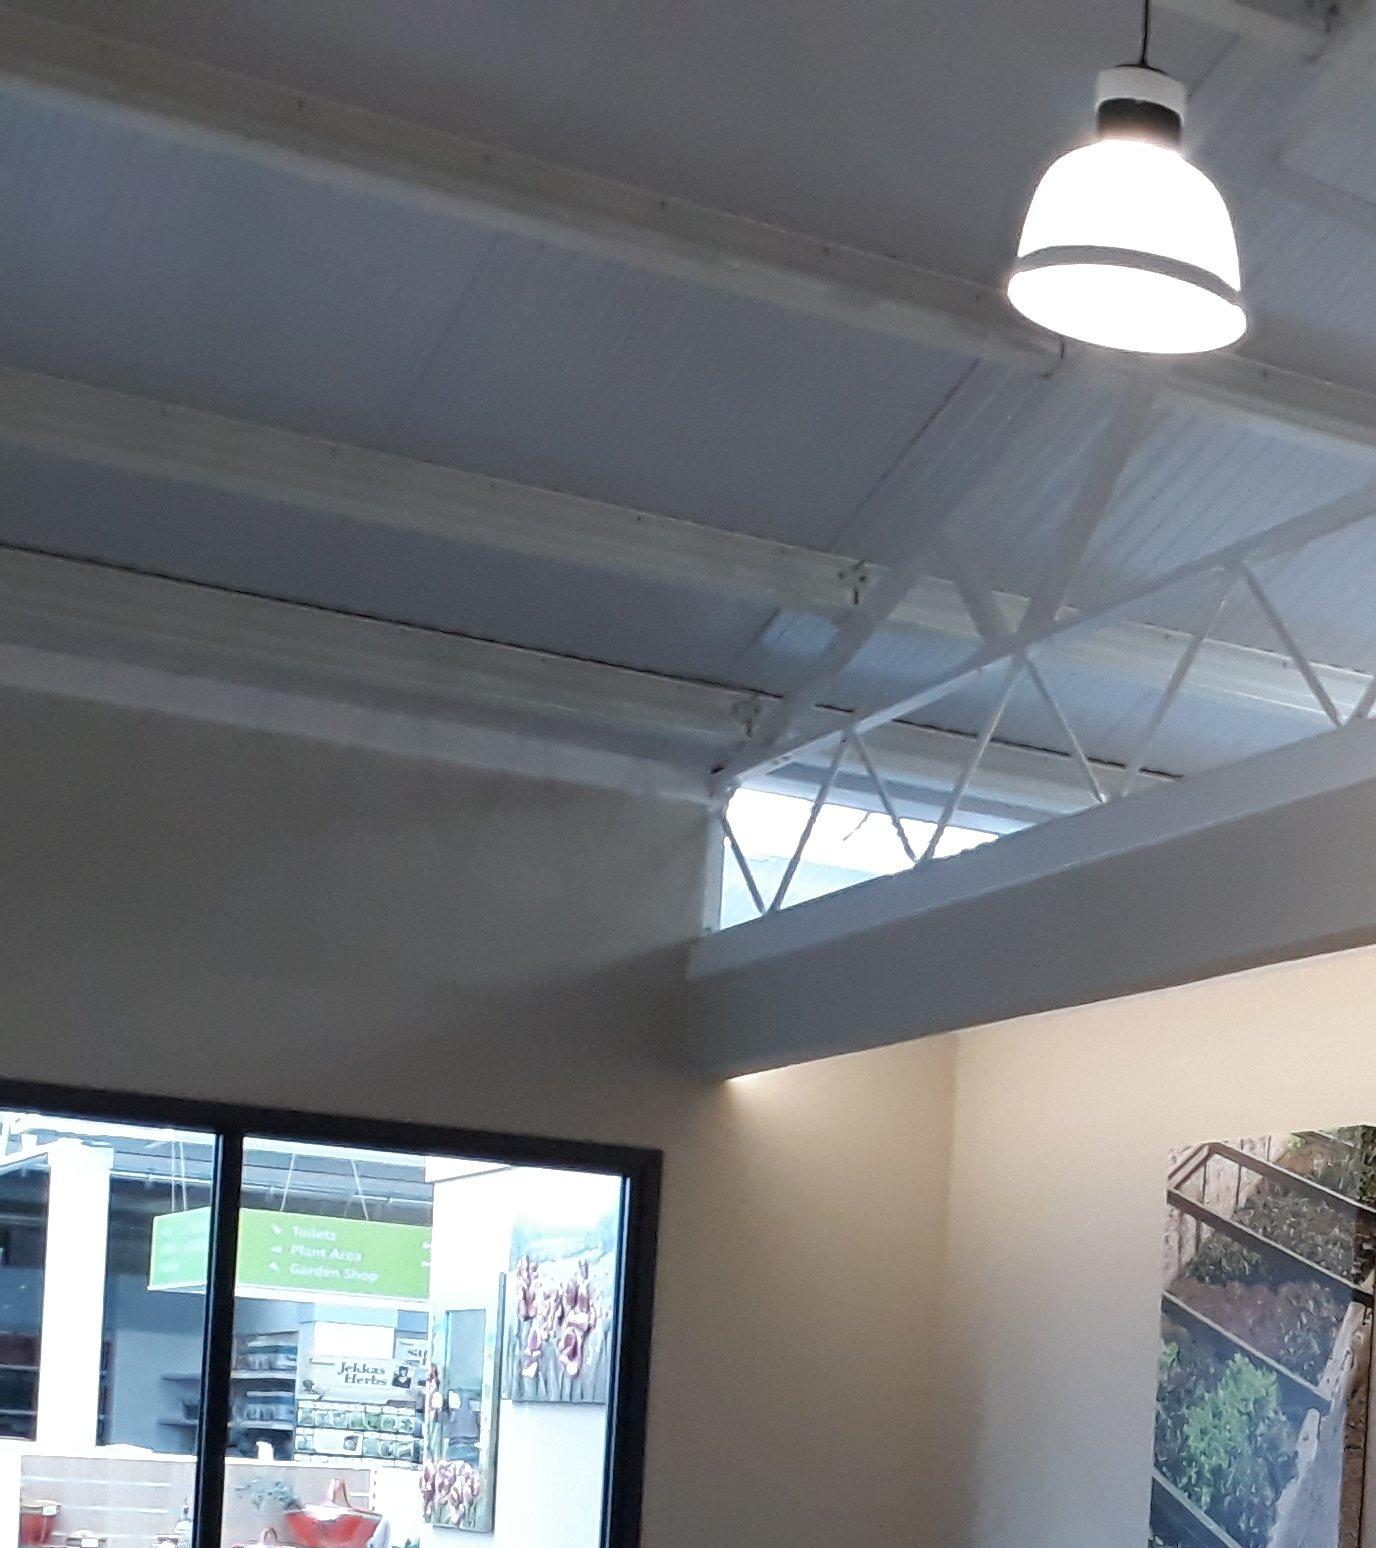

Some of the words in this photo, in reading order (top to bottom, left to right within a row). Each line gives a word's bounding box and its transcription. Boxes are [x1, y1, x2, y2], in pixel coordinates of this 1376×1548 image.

[290, 1245, 327, 1257] Plant
[289, 1263, 340, 1278] Garden
[344, 1267, 378, 1281] Shop
[344, 1373, 388, 1386] Herbs
